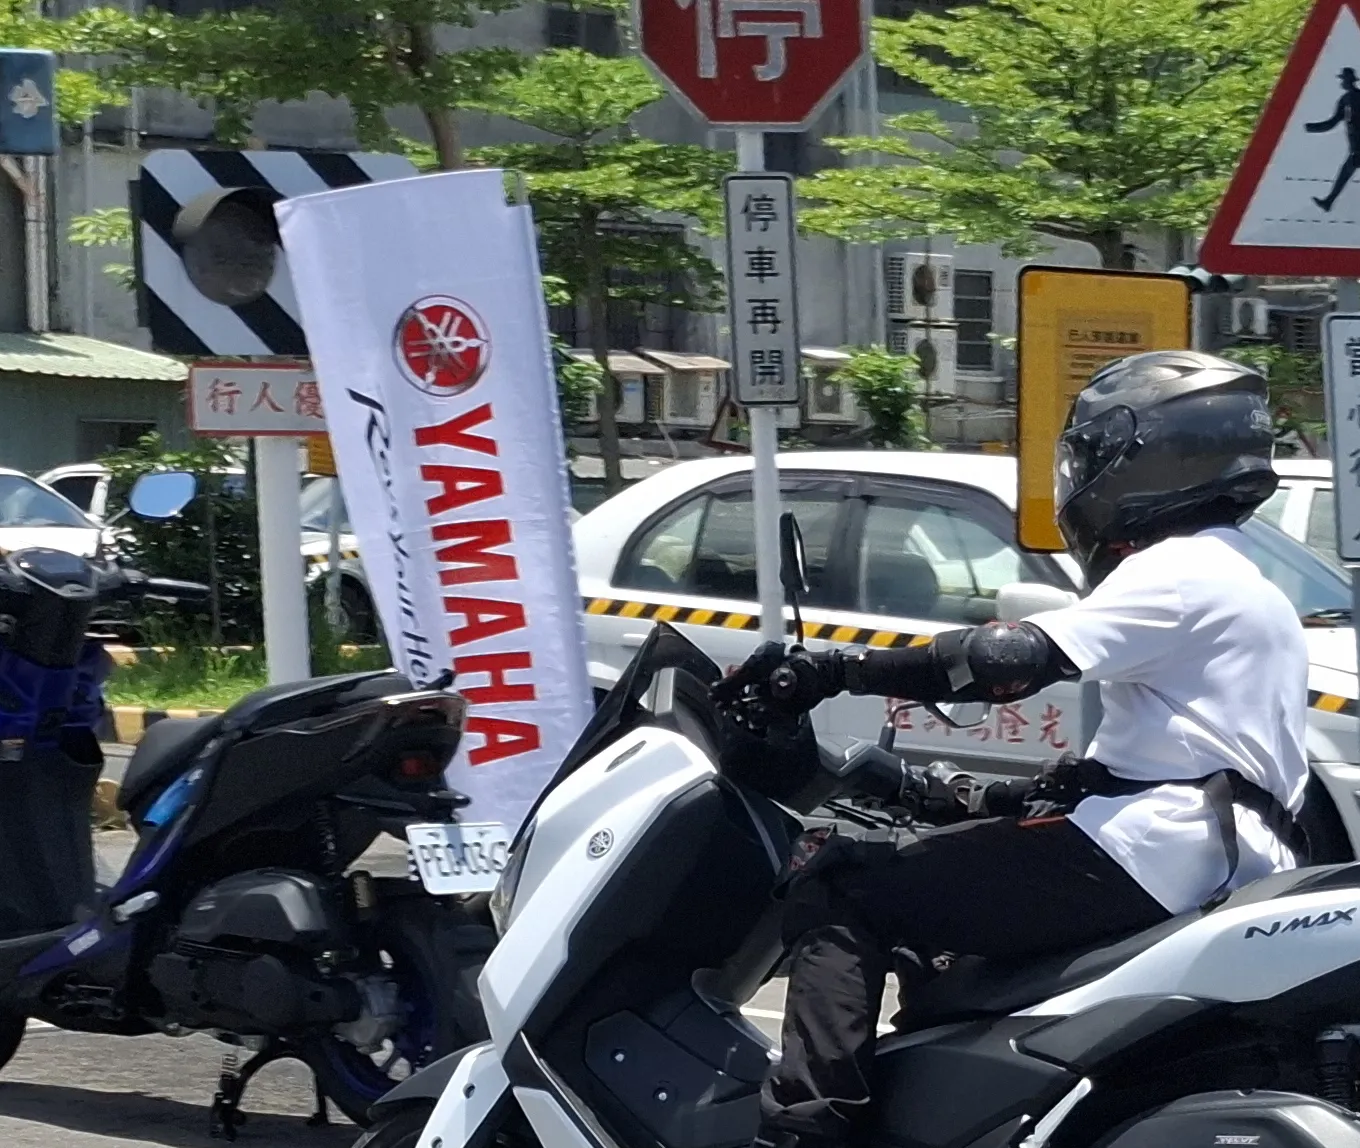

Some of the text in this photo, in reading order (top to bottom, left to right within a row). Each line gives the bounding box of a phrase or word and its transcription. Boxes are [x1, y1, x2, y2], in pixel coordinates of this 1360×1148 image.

[740, 193, 785, 386] 停車再開
[413, 402, 543, 767] YAMAHA
[1244, 907, 1358, 939] NMAX
